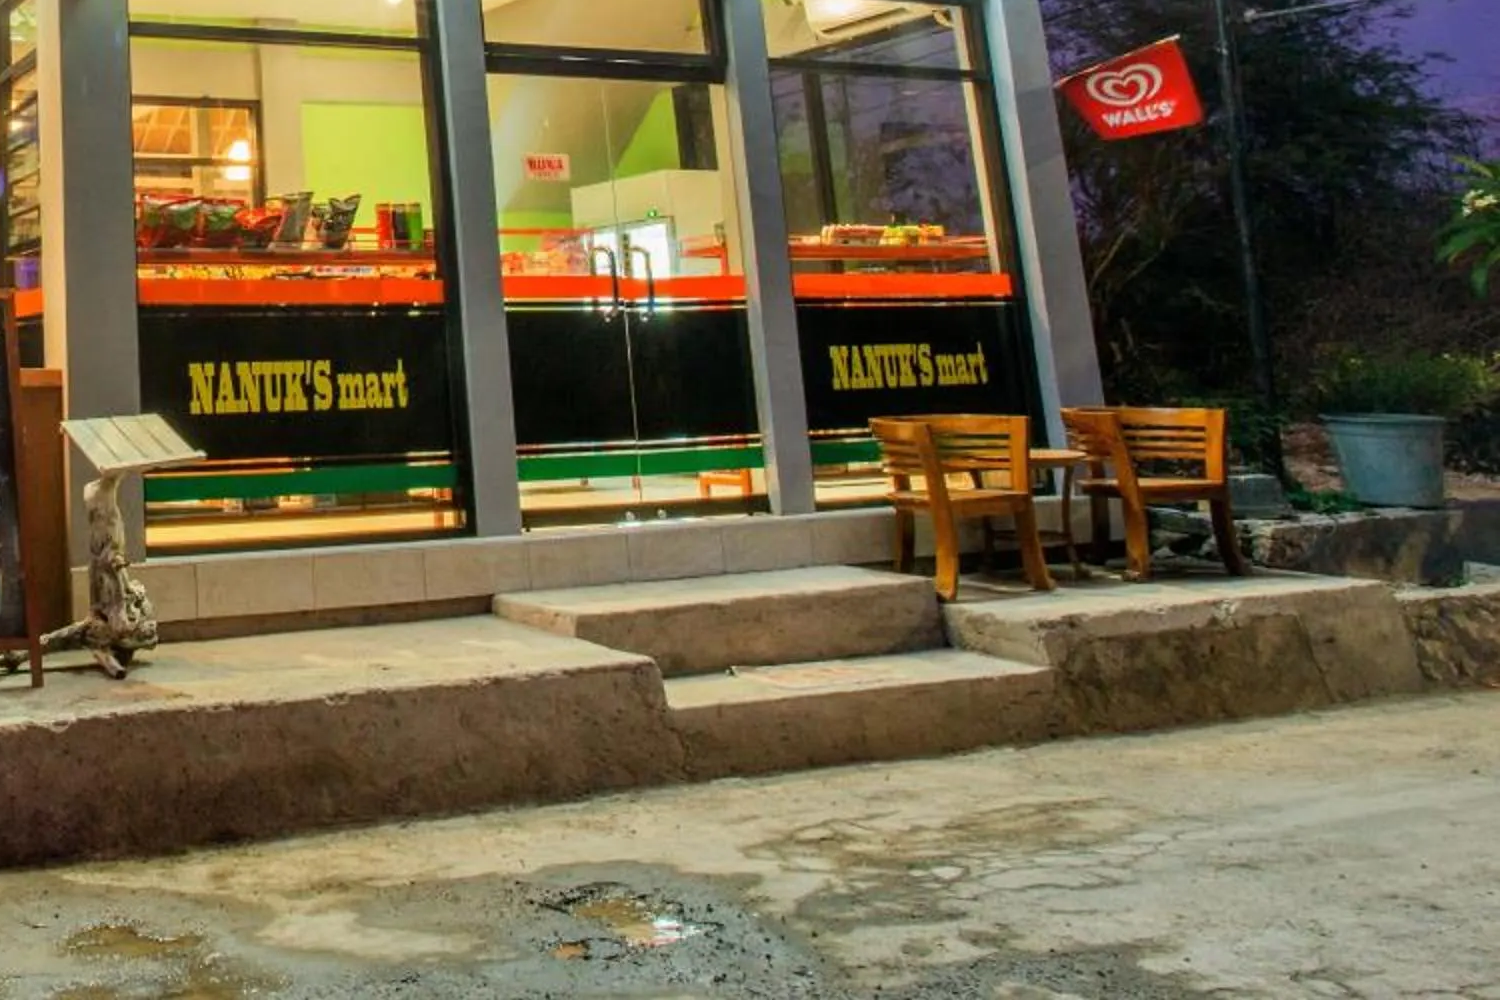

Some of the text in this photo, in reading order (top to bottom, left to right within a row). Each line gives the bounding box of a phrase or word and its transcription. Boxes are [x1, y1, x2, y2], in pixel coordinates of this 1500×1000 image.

[188, 358, 408, 415] NANUK'S mart
[829, 341, 988, 390] NANUK'S mart
